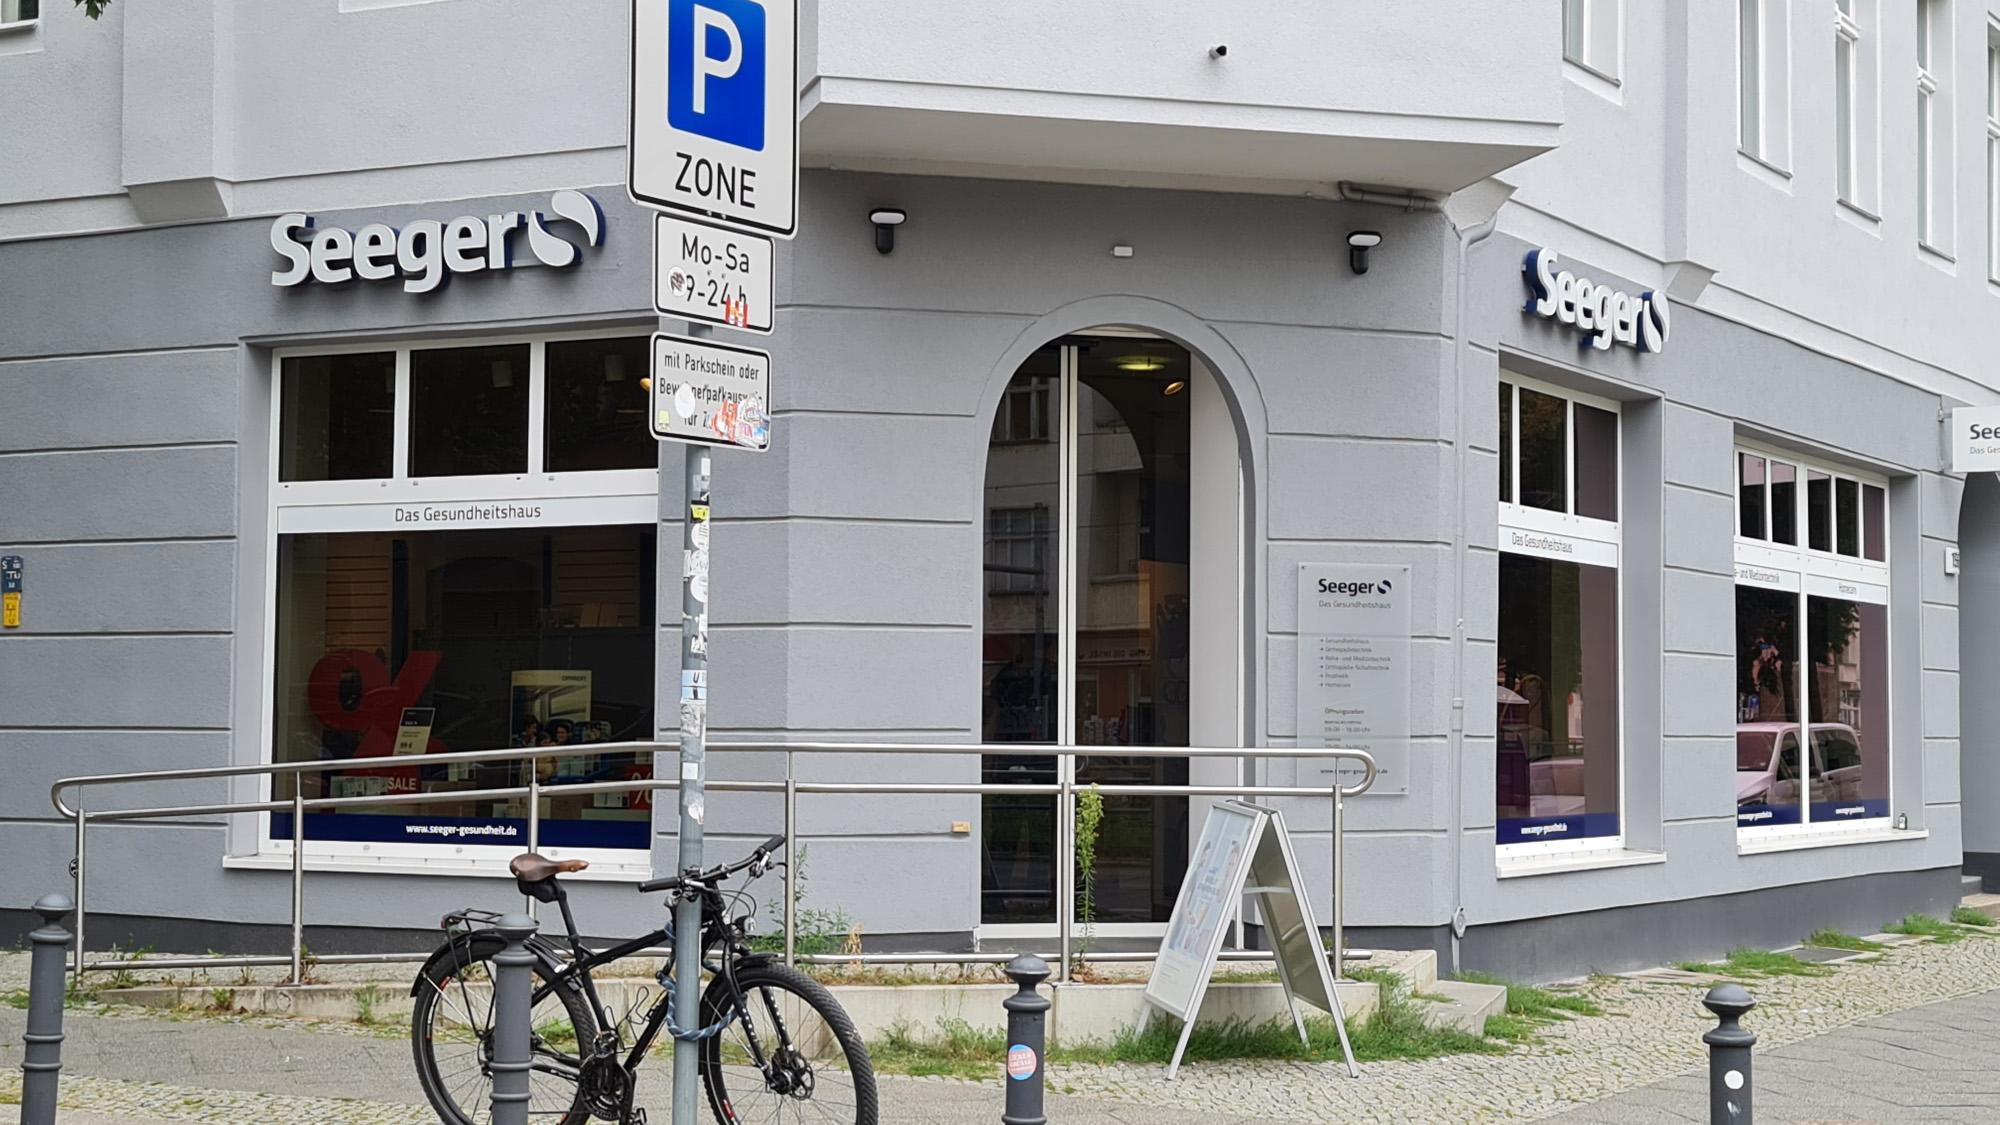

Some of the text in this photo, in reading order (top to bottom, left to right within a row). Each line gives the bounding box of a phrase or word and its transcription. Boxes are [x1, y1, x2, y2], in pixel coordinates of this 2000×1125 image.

[692, 4, 743, 115] P
[675, 152, 756, 209] ZONE
[270, 192, 520, 293] Seeger
[682, 232, 749, 273] Mo-Sa
[1532, 247, 1643, 351] Seeger
[664, 352, 759, 381] mit Parkschein oder
[1969, 446, 1985, 455] Das
[395, 504, 542, 522] Das Gesundheitshaus
[1318, 578, 1375, 597] Seeger
[1318, 600, 1391, 609] Das Gesundheitshaus
[388, 776, 417, 791] SALE
